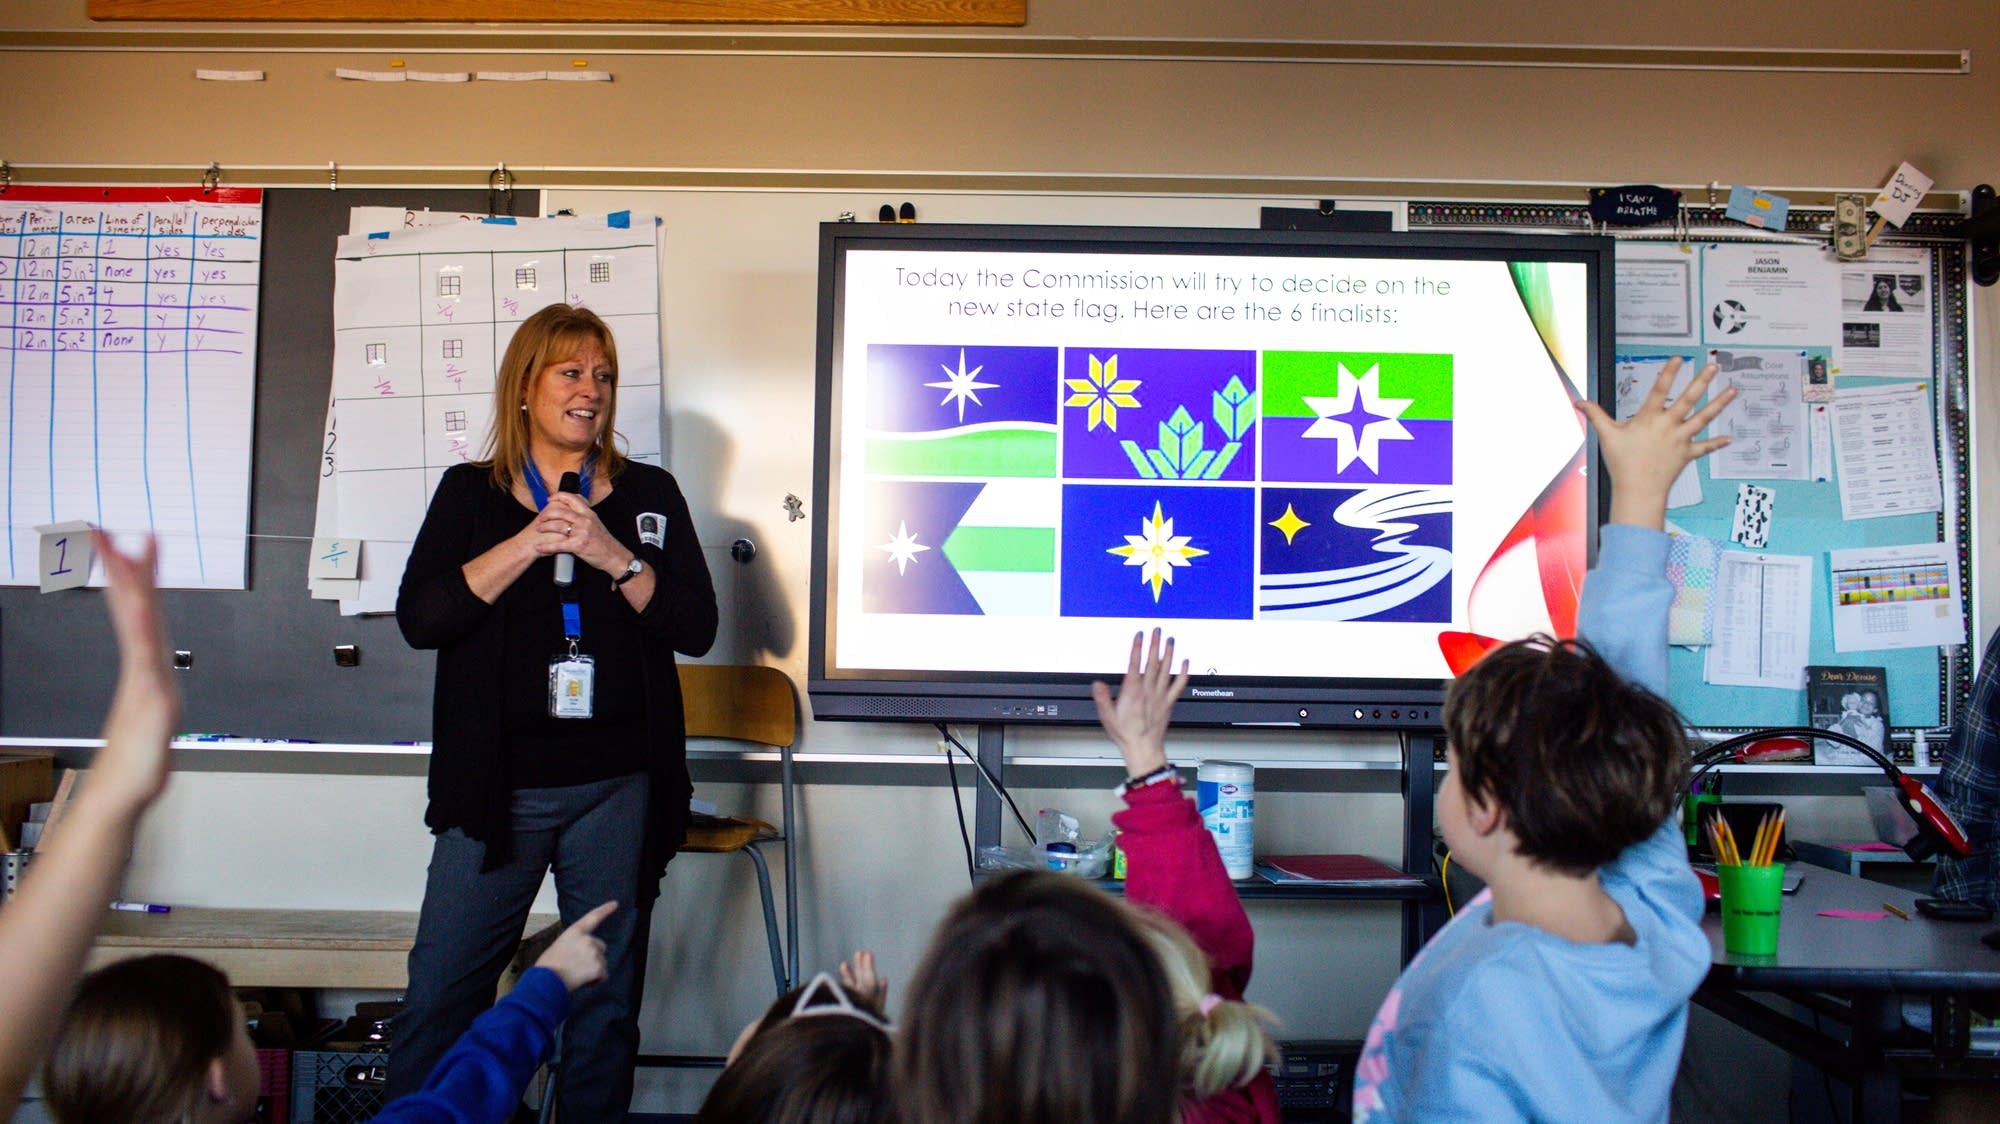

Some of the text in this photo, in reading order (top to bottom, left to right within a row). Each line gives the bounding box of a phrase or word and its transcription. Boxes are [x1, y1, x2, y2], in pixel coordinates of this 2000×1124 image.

[65, 215, 96, 225] area
[132, 213, 144, 224] of
[22, 239, 36, 257] 12
[23, 259, 38, 279] 12
[1747, 266, 1789, 274] BENJAMIN
[1754, 258, 1780, 266] JASON
[896, 267, 1451, 295] Today the Commission will try to decide on the
[21, 284, 37, 300] 12
[21, 308, 35, 323] 12
[103, 308, 118, 325] 2
[949, 298, 1398, 323] new state flag. Here are the 6 finalists:
[20, 330, 35, 349] 12
[324, 432, 337, 455] 2
[322, 456, 335, 478] 3
[50, 537, 73, 576] 1
[1191, 688, 1235, 697] Promethean
